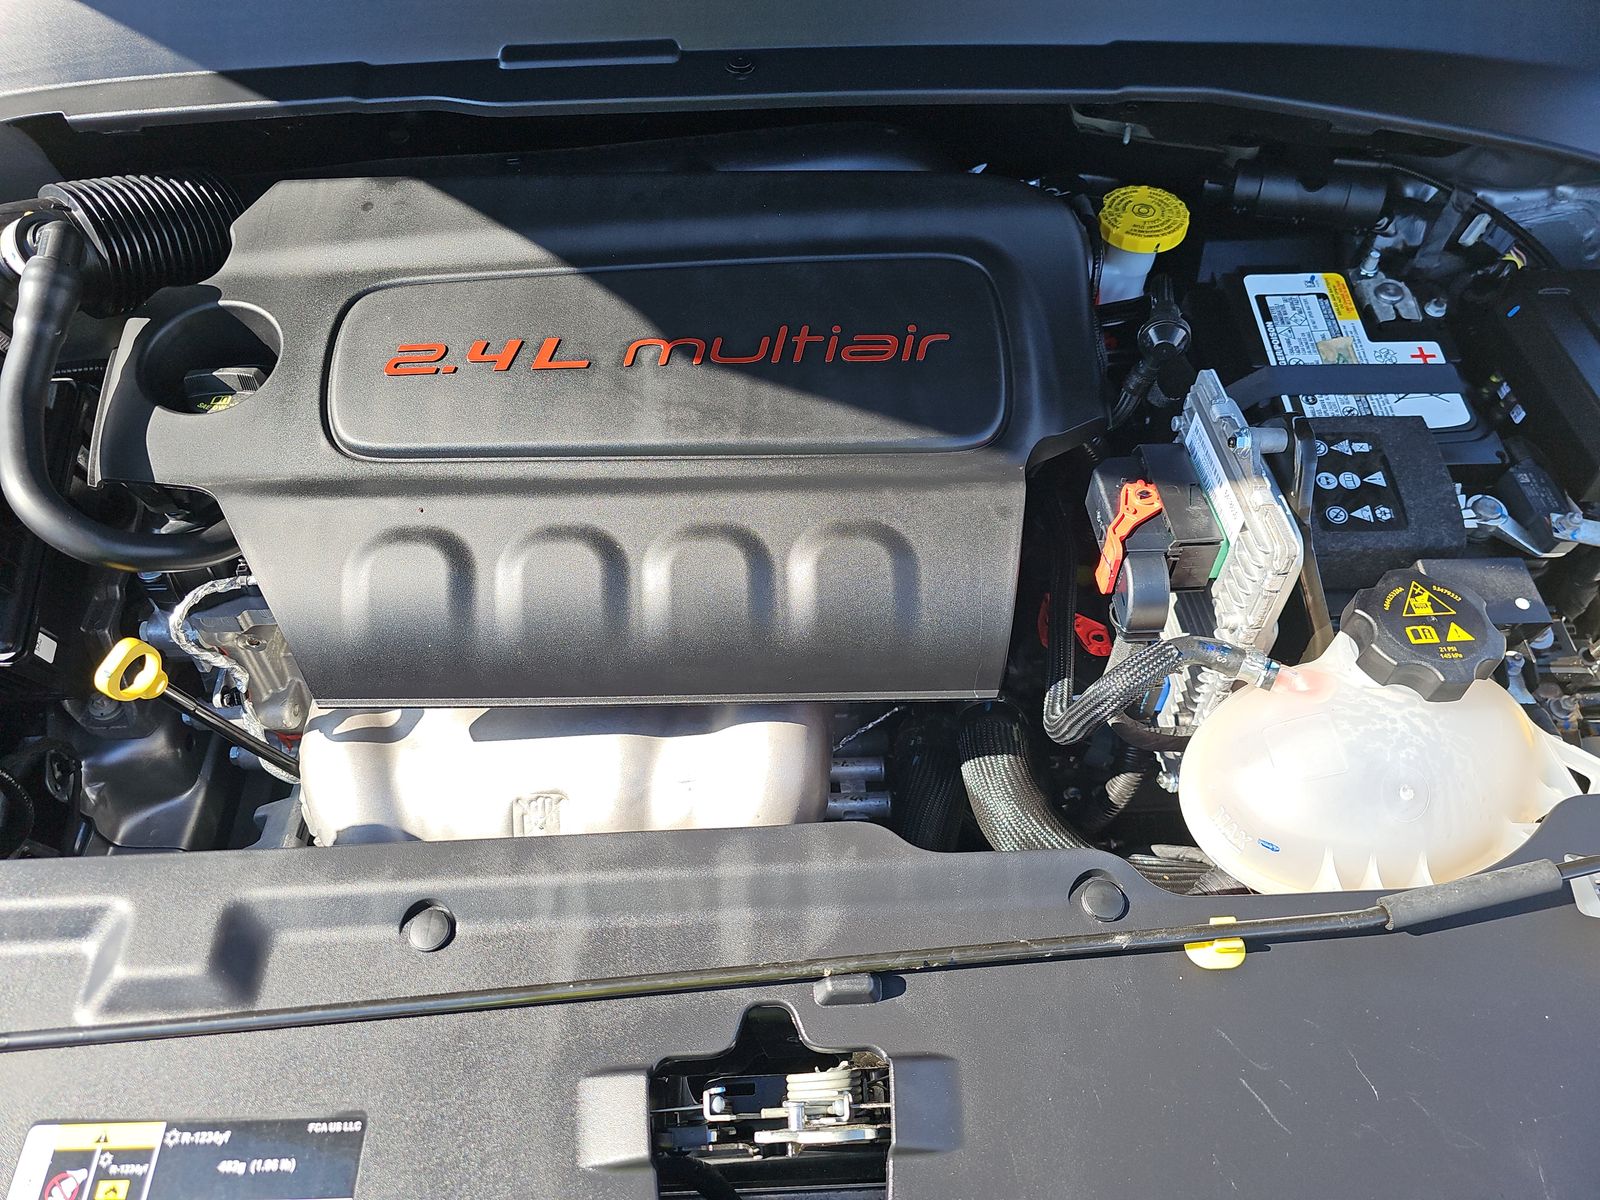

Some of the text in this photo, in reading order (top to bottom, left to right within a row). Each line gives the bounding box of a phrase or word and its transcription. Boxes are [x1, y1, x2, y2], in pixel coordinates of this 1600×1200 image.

[384, 325, 950, 376] 2.4L multiair
[307, 1120, 362, 1134] FCA US LLC
